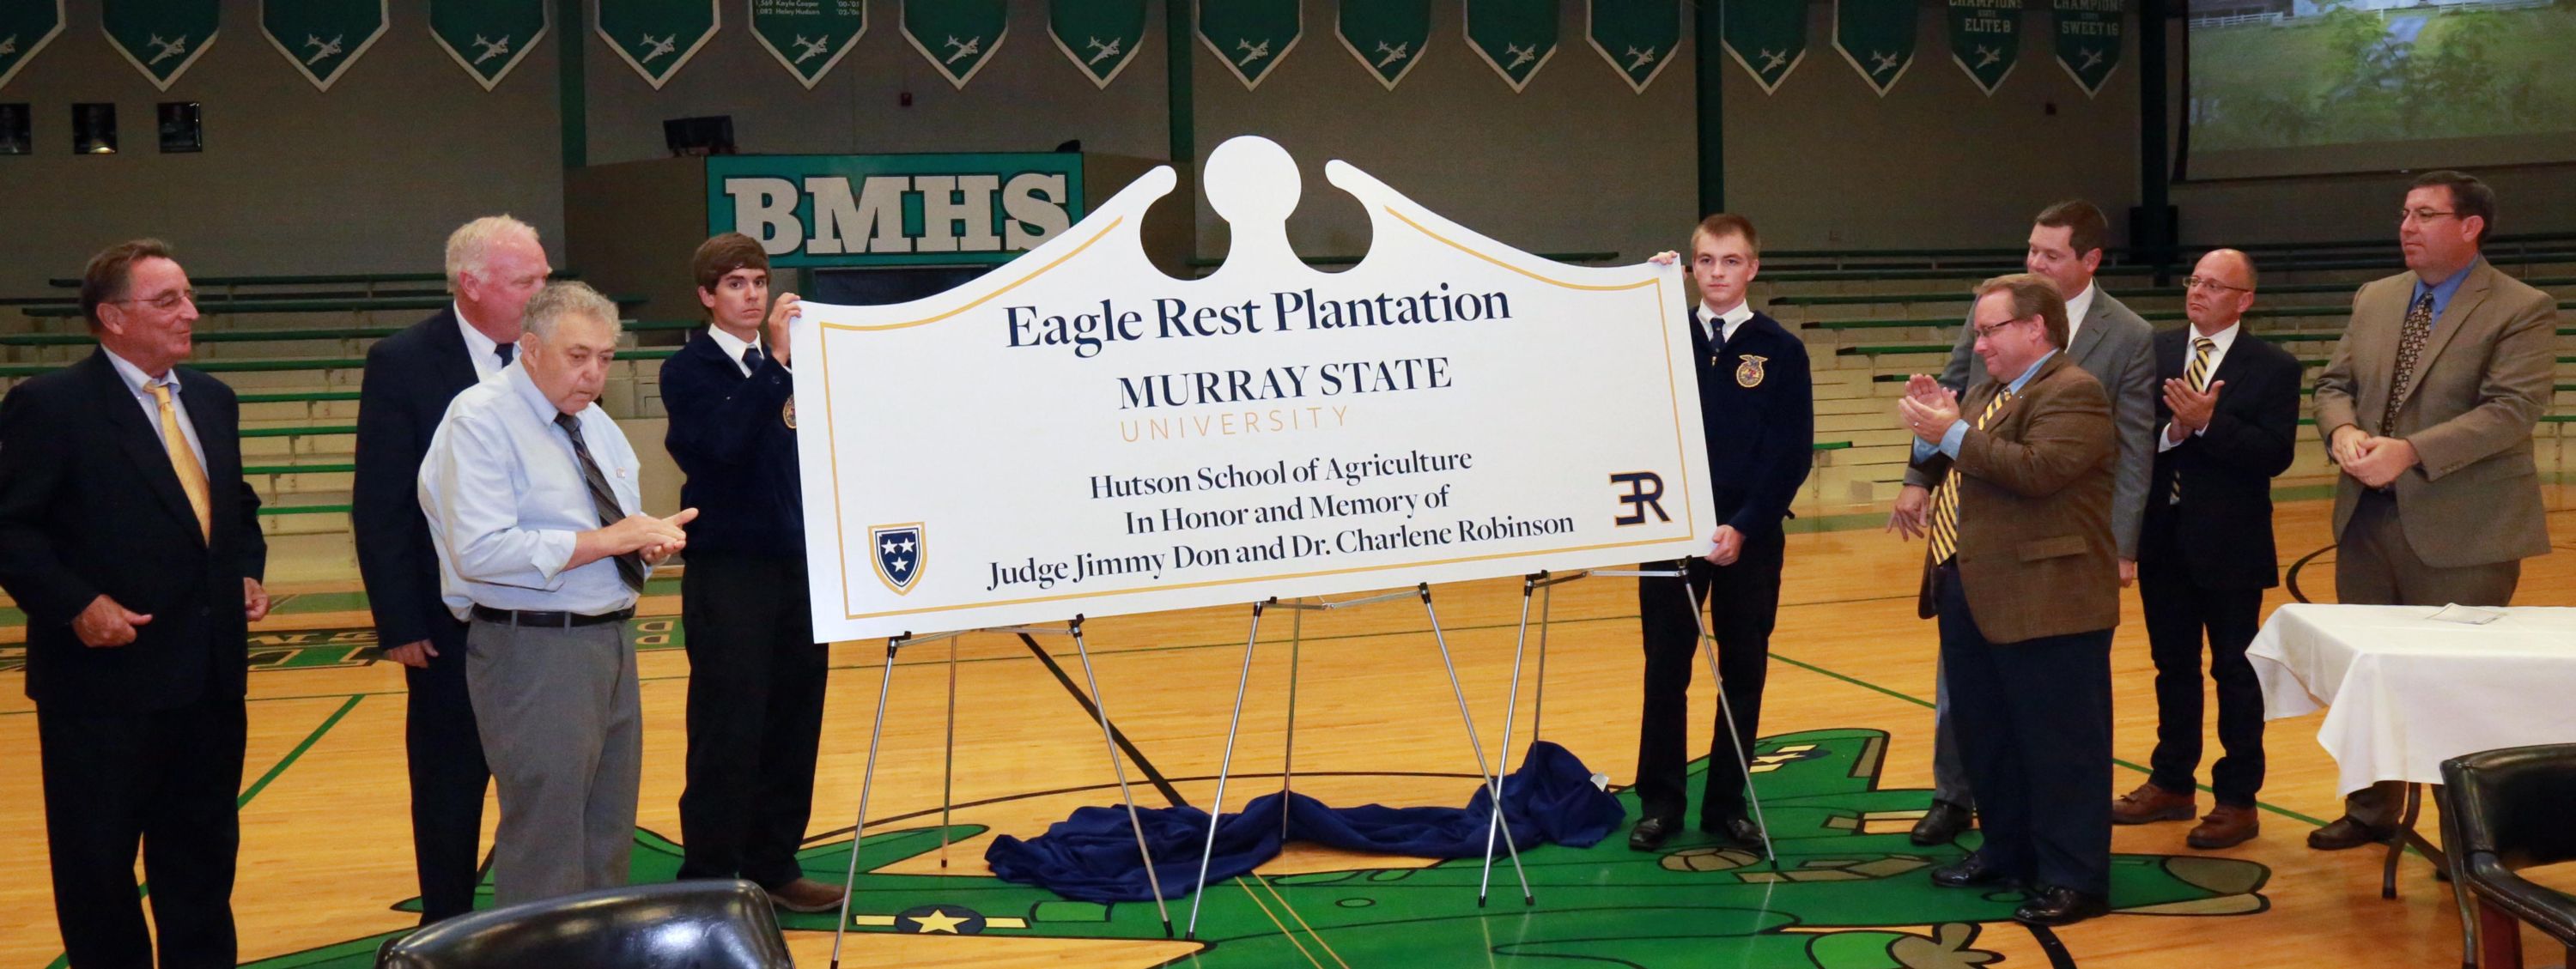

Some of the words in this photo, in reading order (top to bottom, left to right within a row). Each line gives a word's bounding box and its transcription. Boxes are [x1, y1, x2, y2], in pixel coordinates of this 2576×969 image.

[1965, 18, 2001, 32] ELITE
[2002, 20, 2011, 33] 8
[2062, 21, 2104, 35] SWEET
[2107, 22, 2119, 35] 16
[724, 173, 1072, 257] BMHS
[1004, 298, 1144, 359] Eagle
[1152, 298, 1263, 339] Rest
[1270, 282, 1512, 332] Plantation
[1117, 365, 1309, 409] MURRAY
[1320, 356, 1452, 396] STATE
[1120, 405, 1348, 443] UNIVERSITY
[1090, 475, 1191, 500] Hutson
[1197, 461, 1286, 491] School
[1292, 457, 1321, 482] of
[1325, 449, 1473, 487] Agriculture
[1125, 511, 1155, 535] In
[1159, 507, 1249, 532] Honor
[1254, 495, 1303, 524] and
[1309, 494, 1419, 520] Memory
[1424, 483, 1451, 509] of
[986, 556, 1068, 591] Judge
[1072, 552, 1165, 584] Jimmy
[1172, 544, 1230, 569] Don
[1236, 535, 1286, 564] and
[1291, 535, 1331, 558] Dr.
[1335, 524, 1452, 554] Charlene
[1457, 515, 1575, 542] Robinson
